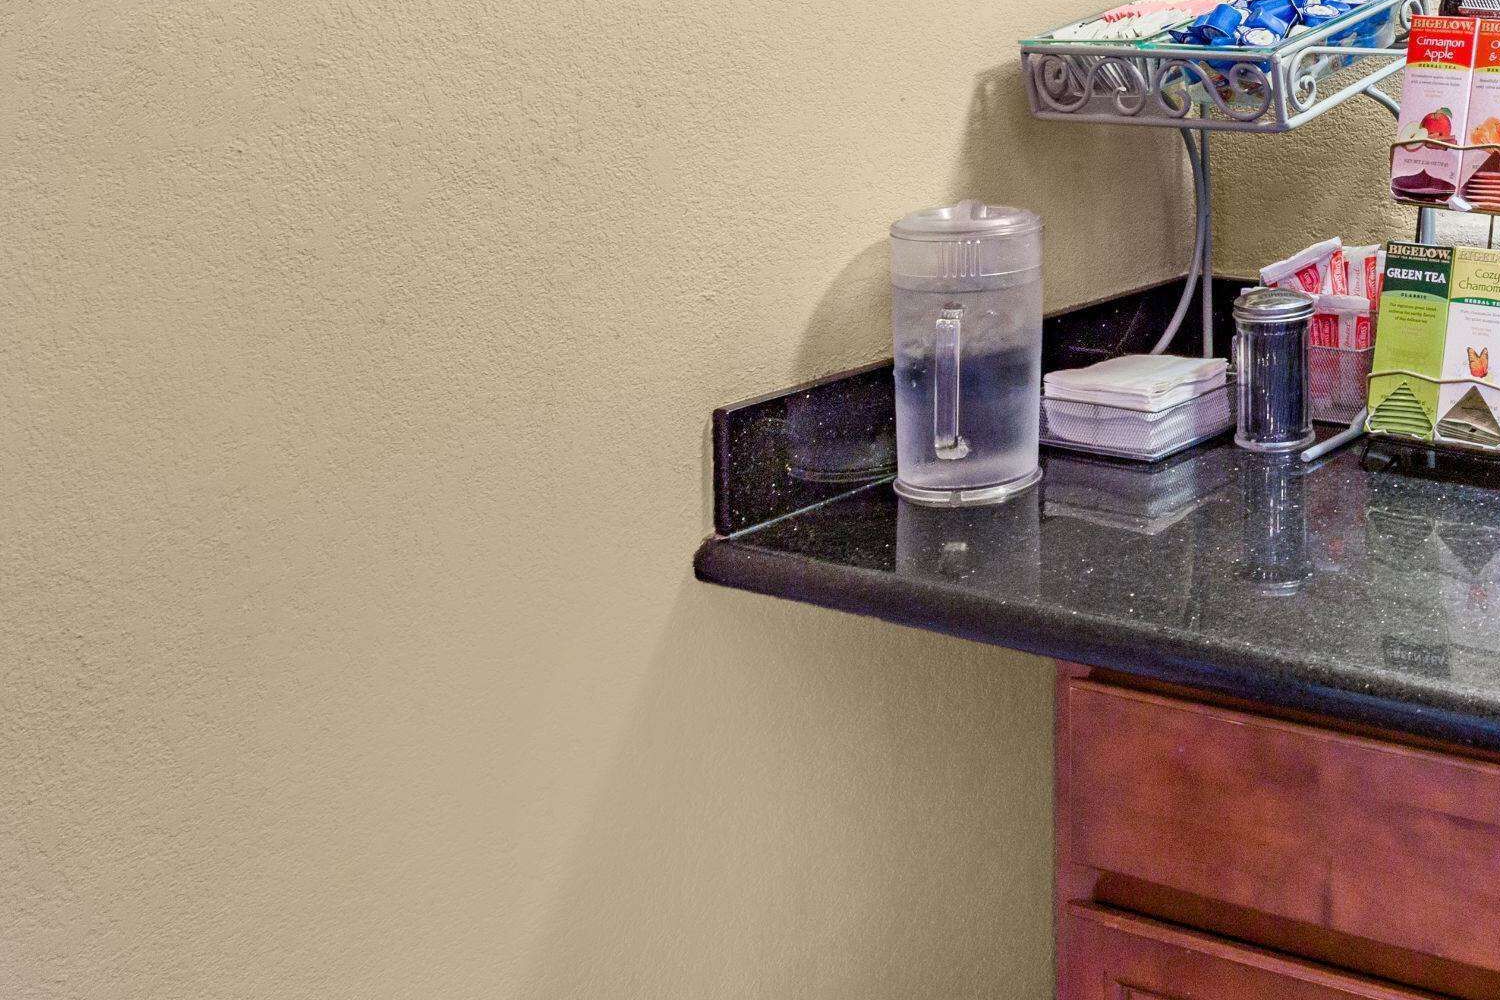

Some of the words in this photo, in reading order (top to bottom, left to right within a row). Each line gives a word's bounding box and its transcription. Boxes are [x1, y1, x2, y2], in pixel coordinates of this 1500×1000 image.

[1416, 36, 1465, 48] Cinnamon
[1424, 47, 1454, 62] Apple
[1489, 52, 1497, 62] &
[1388, 245, 1451, 260] BIGELOW
[1387, 267, 1423, 280] GREEN
[1424, 271, 1446, 284] TEA
[1475, 269, 1500, 284] Cozy
